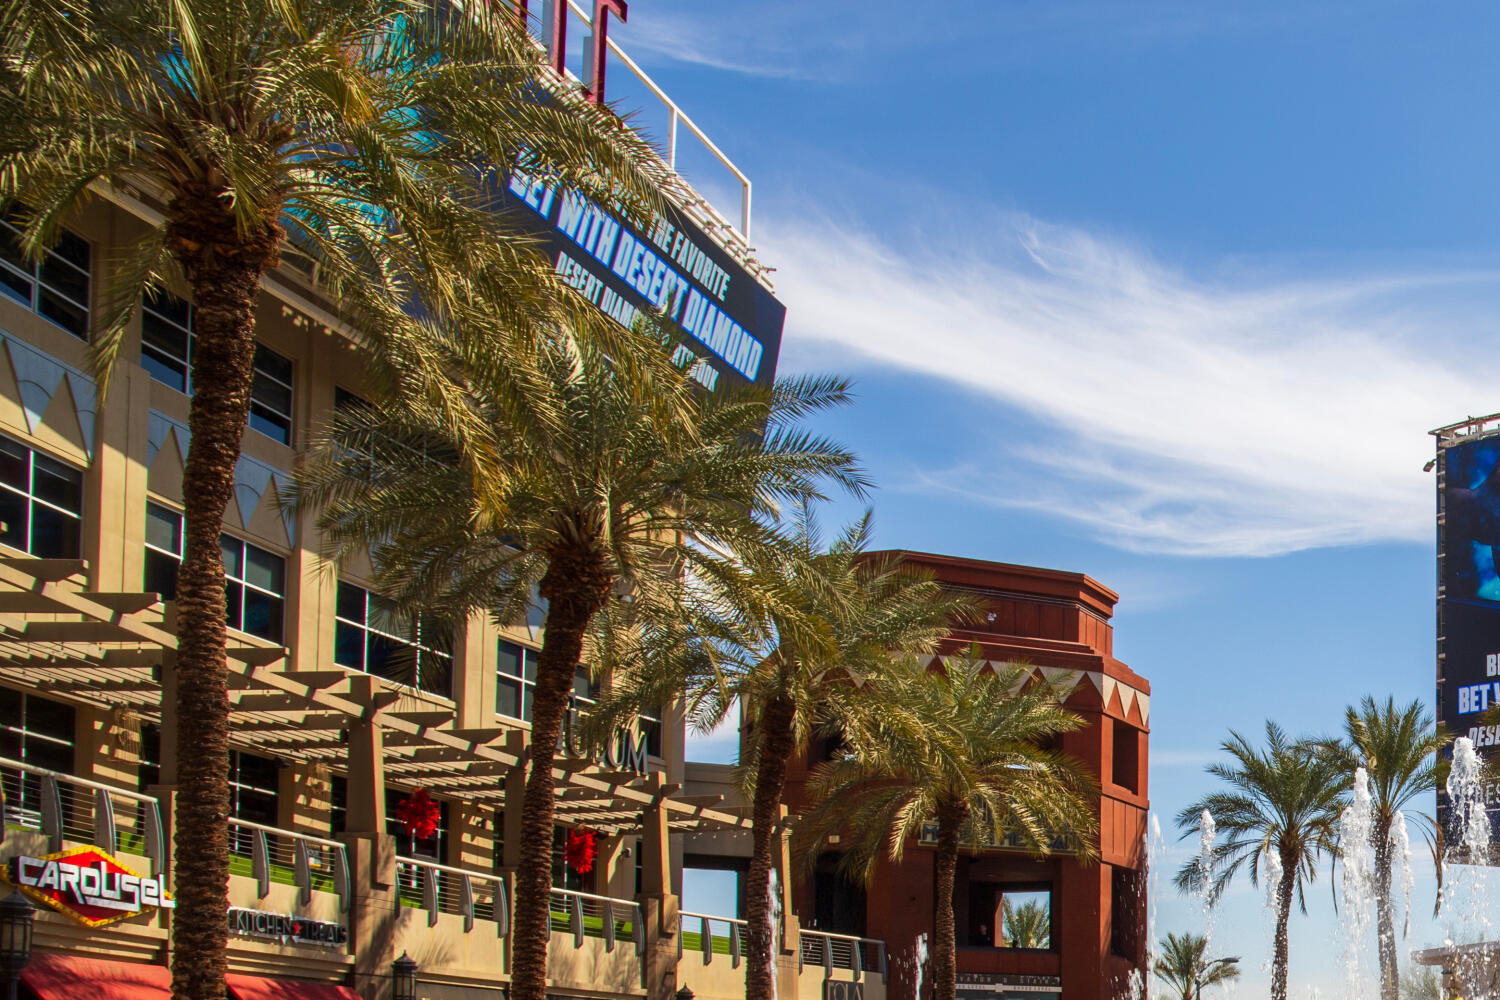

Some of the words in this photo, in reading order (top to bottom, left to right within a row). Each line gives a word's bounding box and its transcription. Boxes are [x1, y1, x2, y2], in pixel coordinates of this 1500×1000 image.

[555, 251, 604, 306] DESERT
[556, 180, 621, 269] WITH
[611, 227, 690, 322] DESERT
[681, 286, 763, 382] DIAMOND
[670, 231, 731, 302] FAVORITE
[1458, 682, 1491, 715] BET
[18, 855, 176, 912] CAROUSEL
[236, 910, 292, 936] KITCHEN
